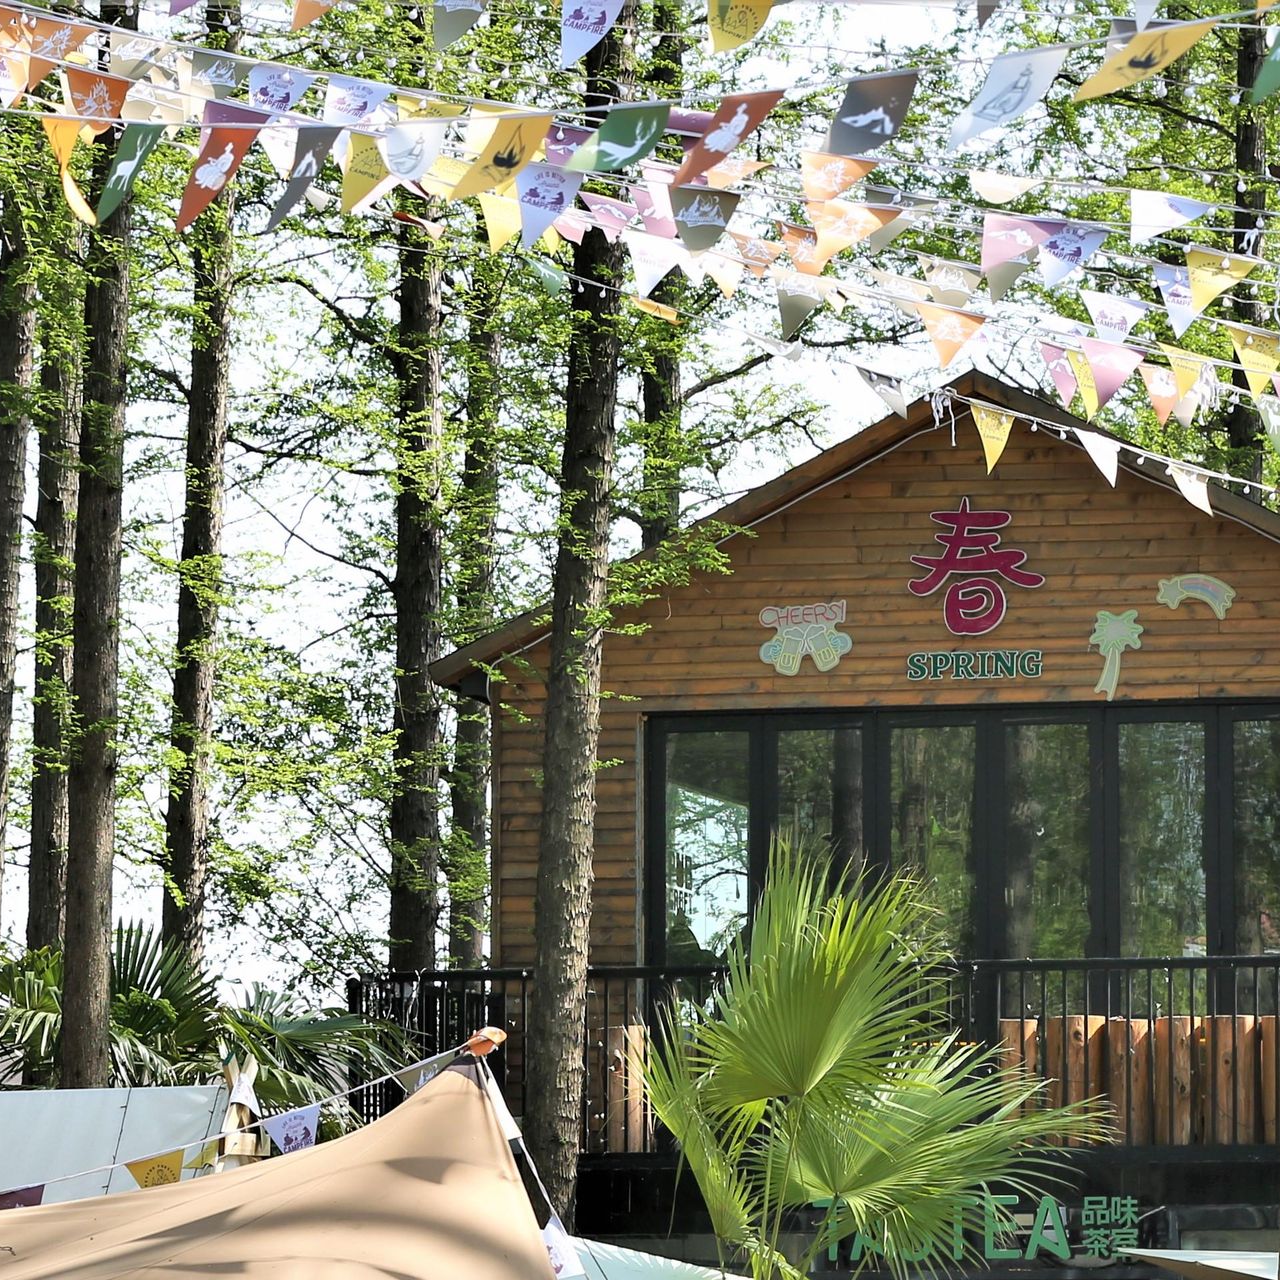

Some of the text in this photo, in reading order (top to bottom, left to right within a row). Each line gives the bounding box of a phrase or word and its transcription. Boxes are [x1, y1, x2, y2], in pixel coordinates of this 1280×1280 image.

[562, 18, 605, 35] CAMPFIRE
[521, 195, 565, 213] CAMPFIRE
[907, 496, 1046, 637] 春
[760, 600, 846, 627] CHEERS!
[907, 649, 1044, 681] SPRING
[1081, 1195, 1139, 1227] 品味
